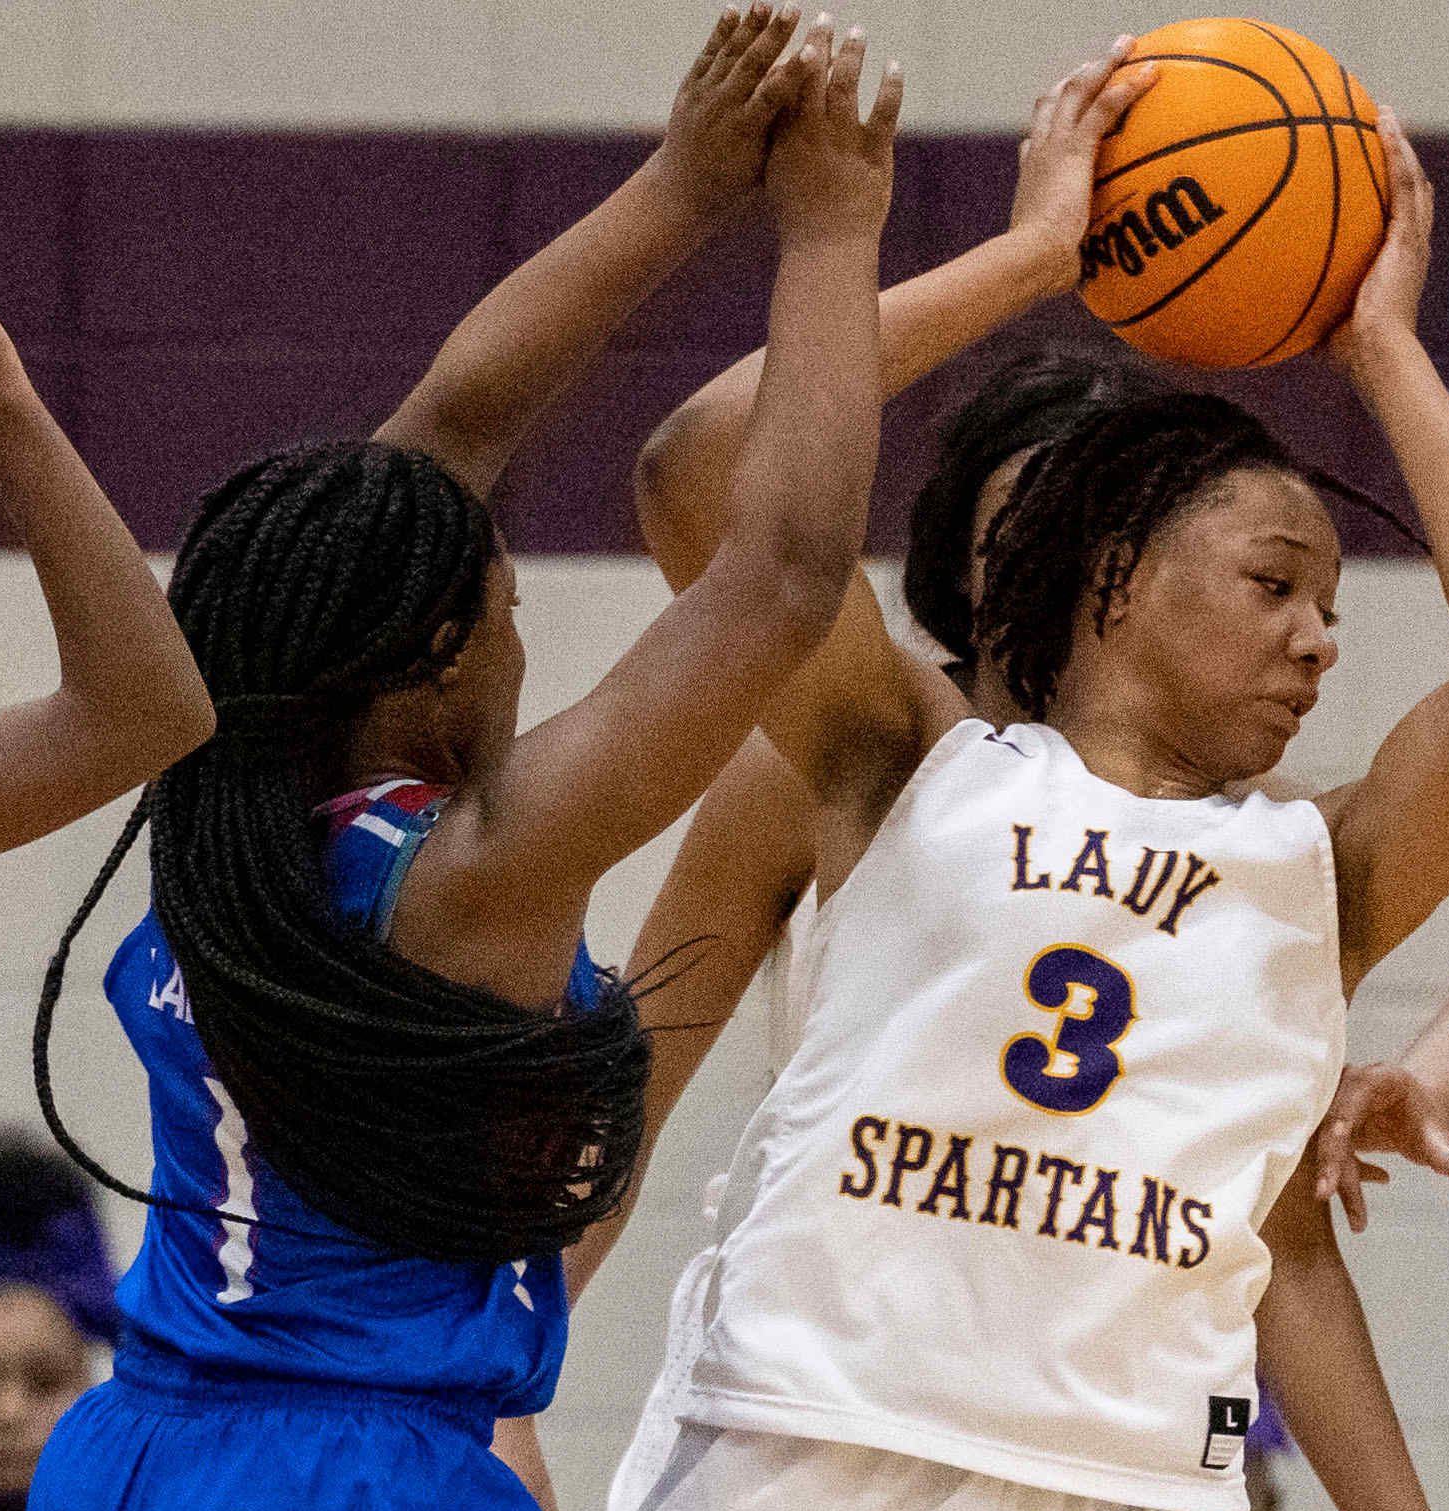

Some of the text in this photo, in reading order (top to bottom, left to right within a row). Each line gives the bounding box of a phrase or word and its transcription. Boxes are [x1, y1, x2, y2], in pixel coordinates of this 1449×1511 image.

[1012, 823, 1221, 938] LADY
[999, 942, 1141, 1117] 3
[837, 1113, 1215, 1271] SPARTANS
[1225, 1405, 1239, 1428] L
